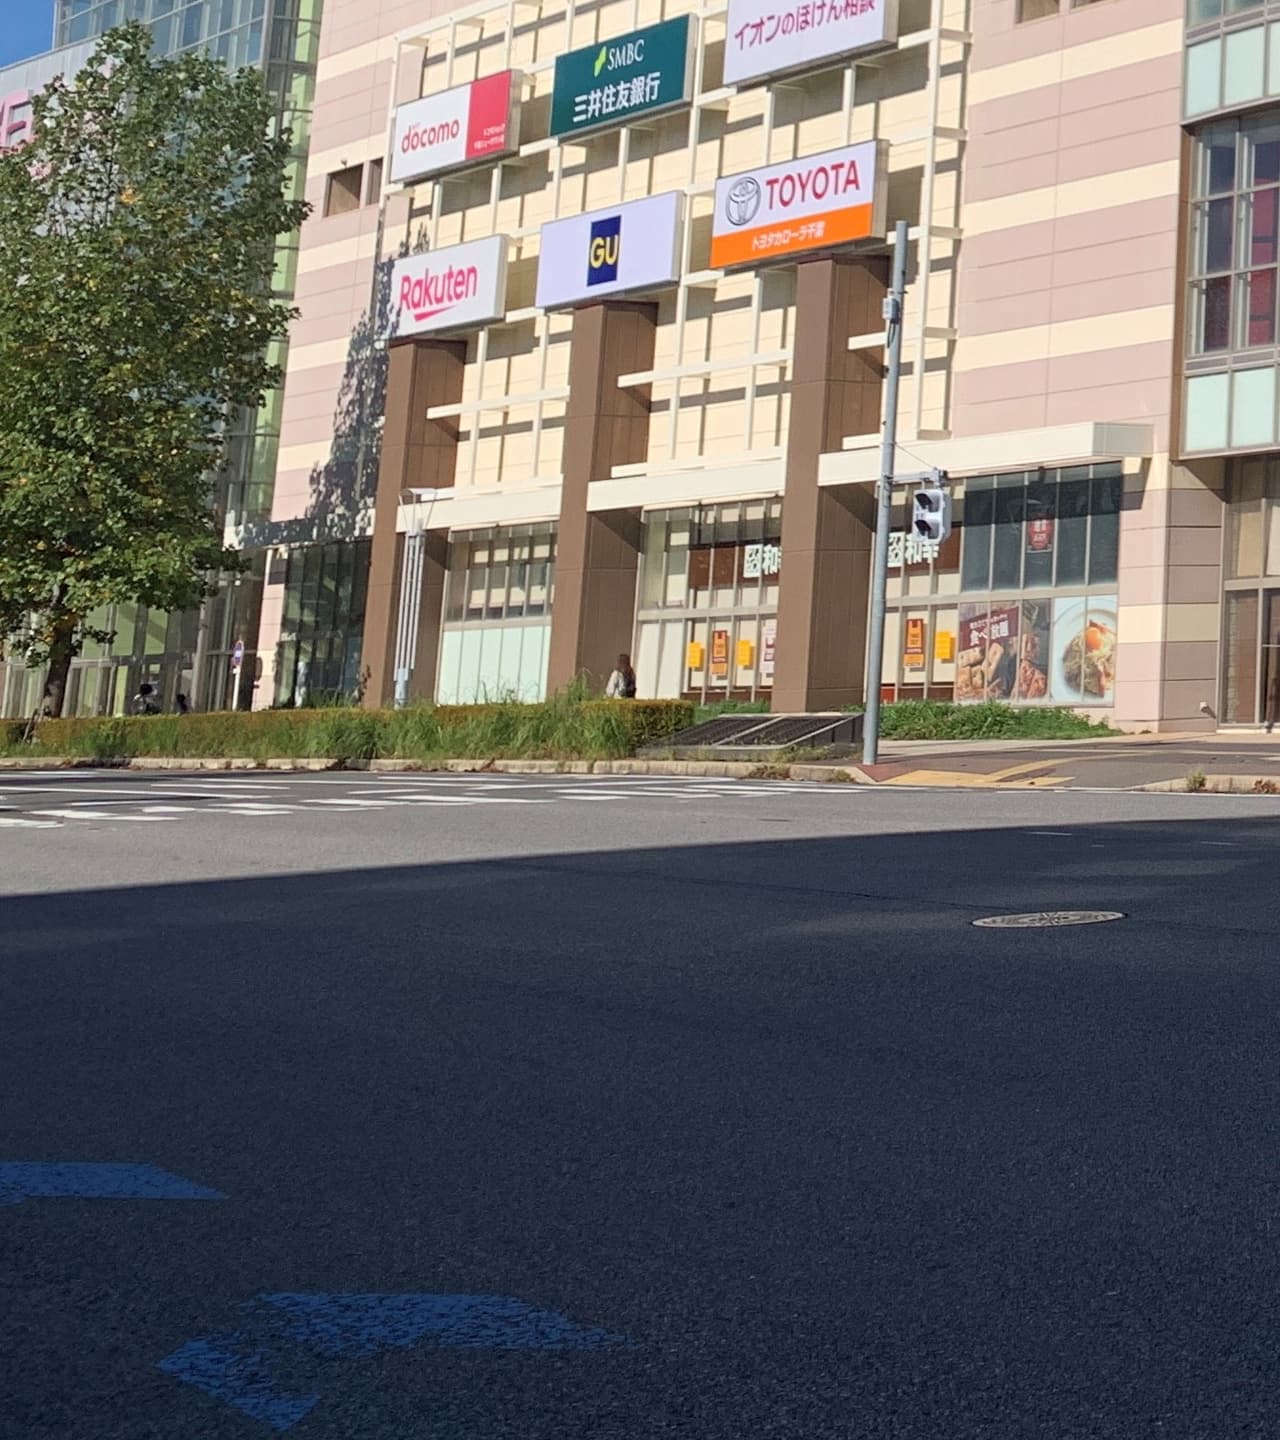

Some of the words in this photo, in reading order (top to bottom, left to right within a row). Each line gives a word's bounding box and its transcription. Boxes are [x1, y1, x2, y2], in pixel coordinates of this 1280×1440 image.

[607, 39, 645, 71] SMBC
[572, 71, 661, 123] 三井住友銀行
[401, 118, 460, 154] docomo
[766, 160, 860, 210] TOYOTA
[590, 234, 619, 269] GU
[400, 264, 478, 311] Rakuten
[743, 544, 783, 578] 昭和
